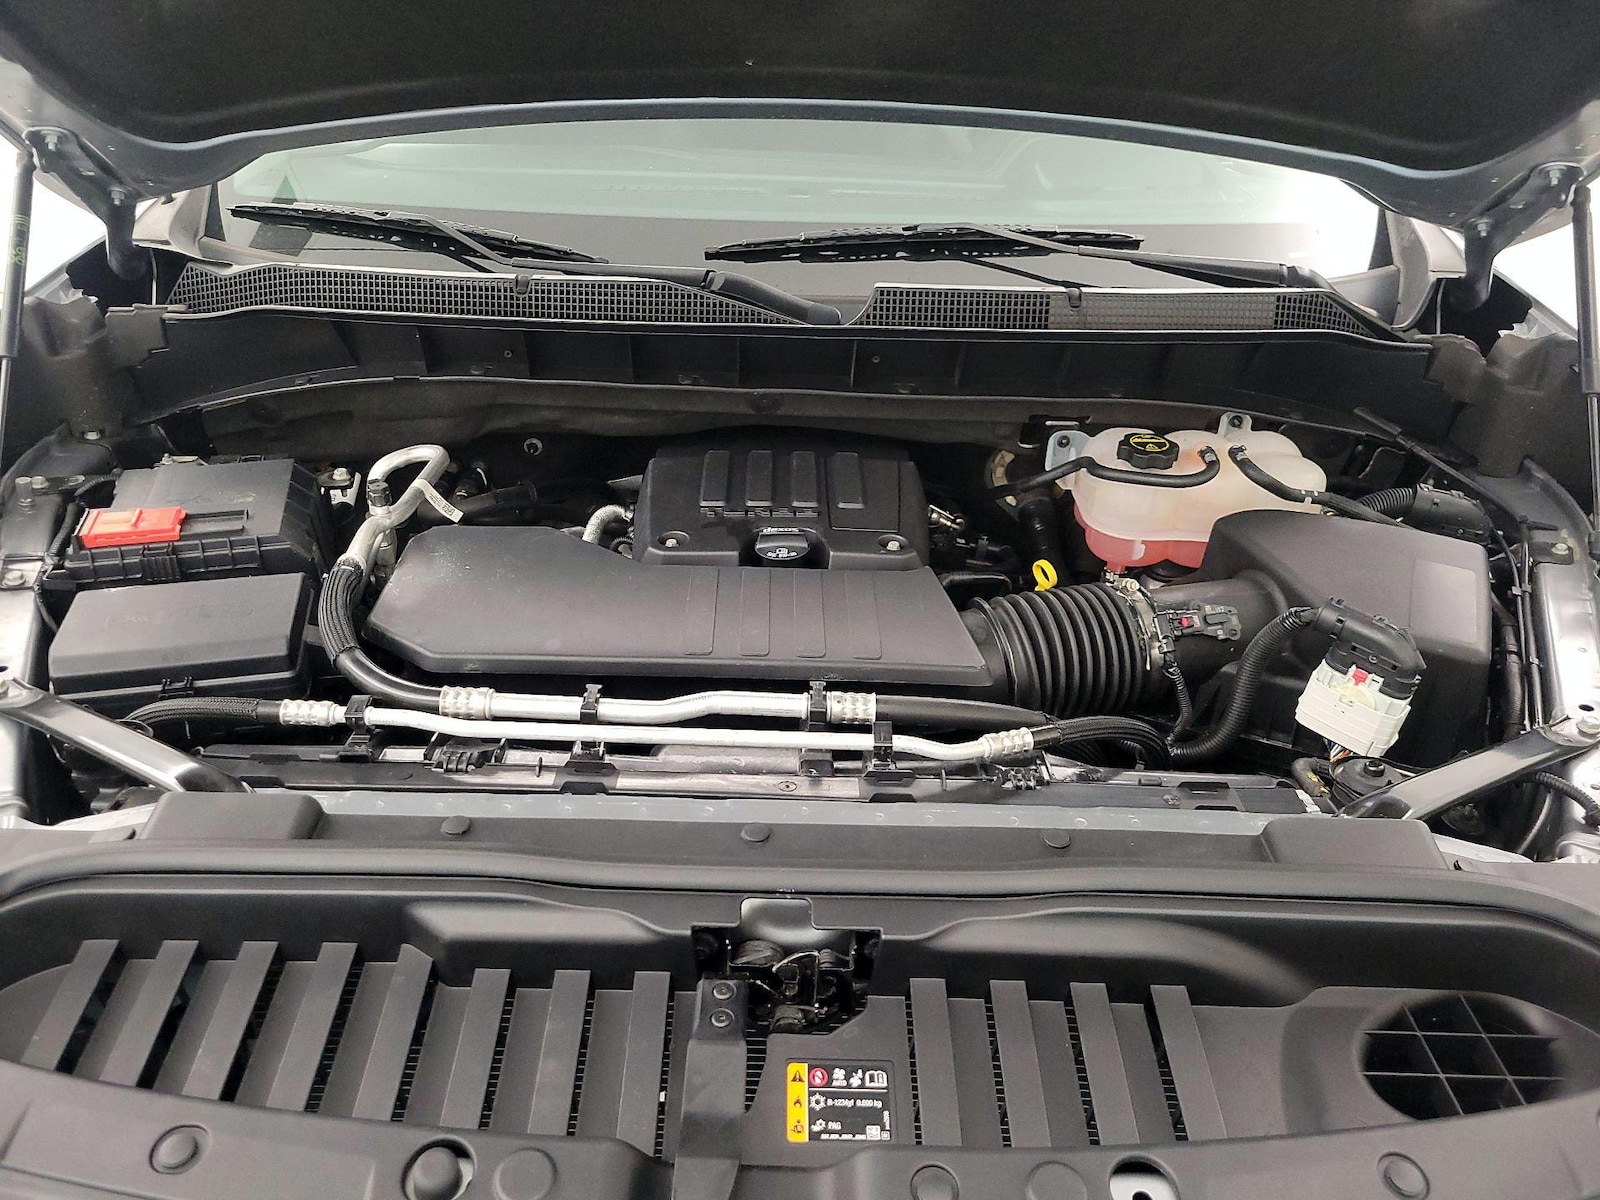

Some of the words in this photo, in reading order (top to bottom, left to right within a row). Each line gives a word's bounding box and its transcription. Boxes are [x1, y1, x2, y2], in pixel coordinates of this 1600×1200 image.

[827, 1098, 854, 1108] R-1234yf
[874, 1099, 882, 1108] kg
[828, 1121, 841, 1130] PAG
